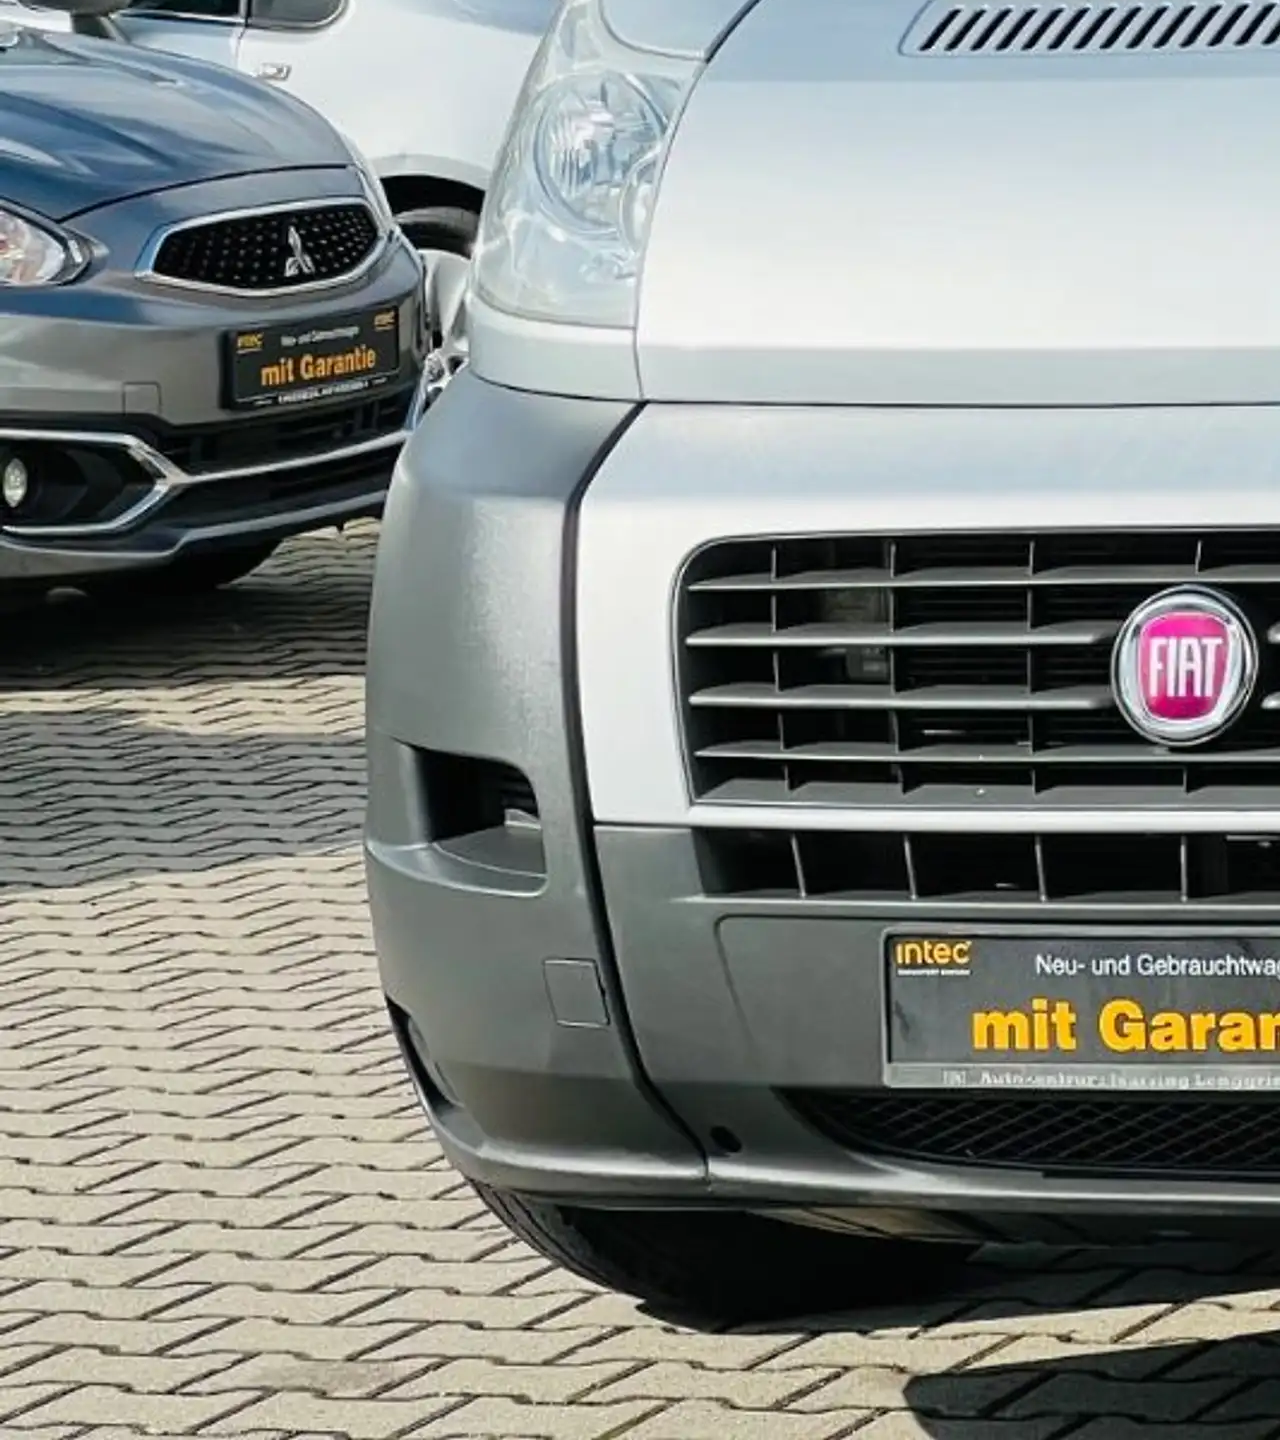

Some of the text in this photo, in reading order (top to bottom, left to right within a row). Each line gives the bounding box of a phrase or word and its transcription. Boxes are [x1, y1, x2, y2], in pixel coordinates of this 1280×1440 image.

[261, 343, 377, 386] mit Garantie
[1150, 636, 1224, 698] FIAT
[1035, 953, 1086, 977] Neu-
[1091, 953, 1132, 977] und
[971, 998, 1078, 1051] mit
